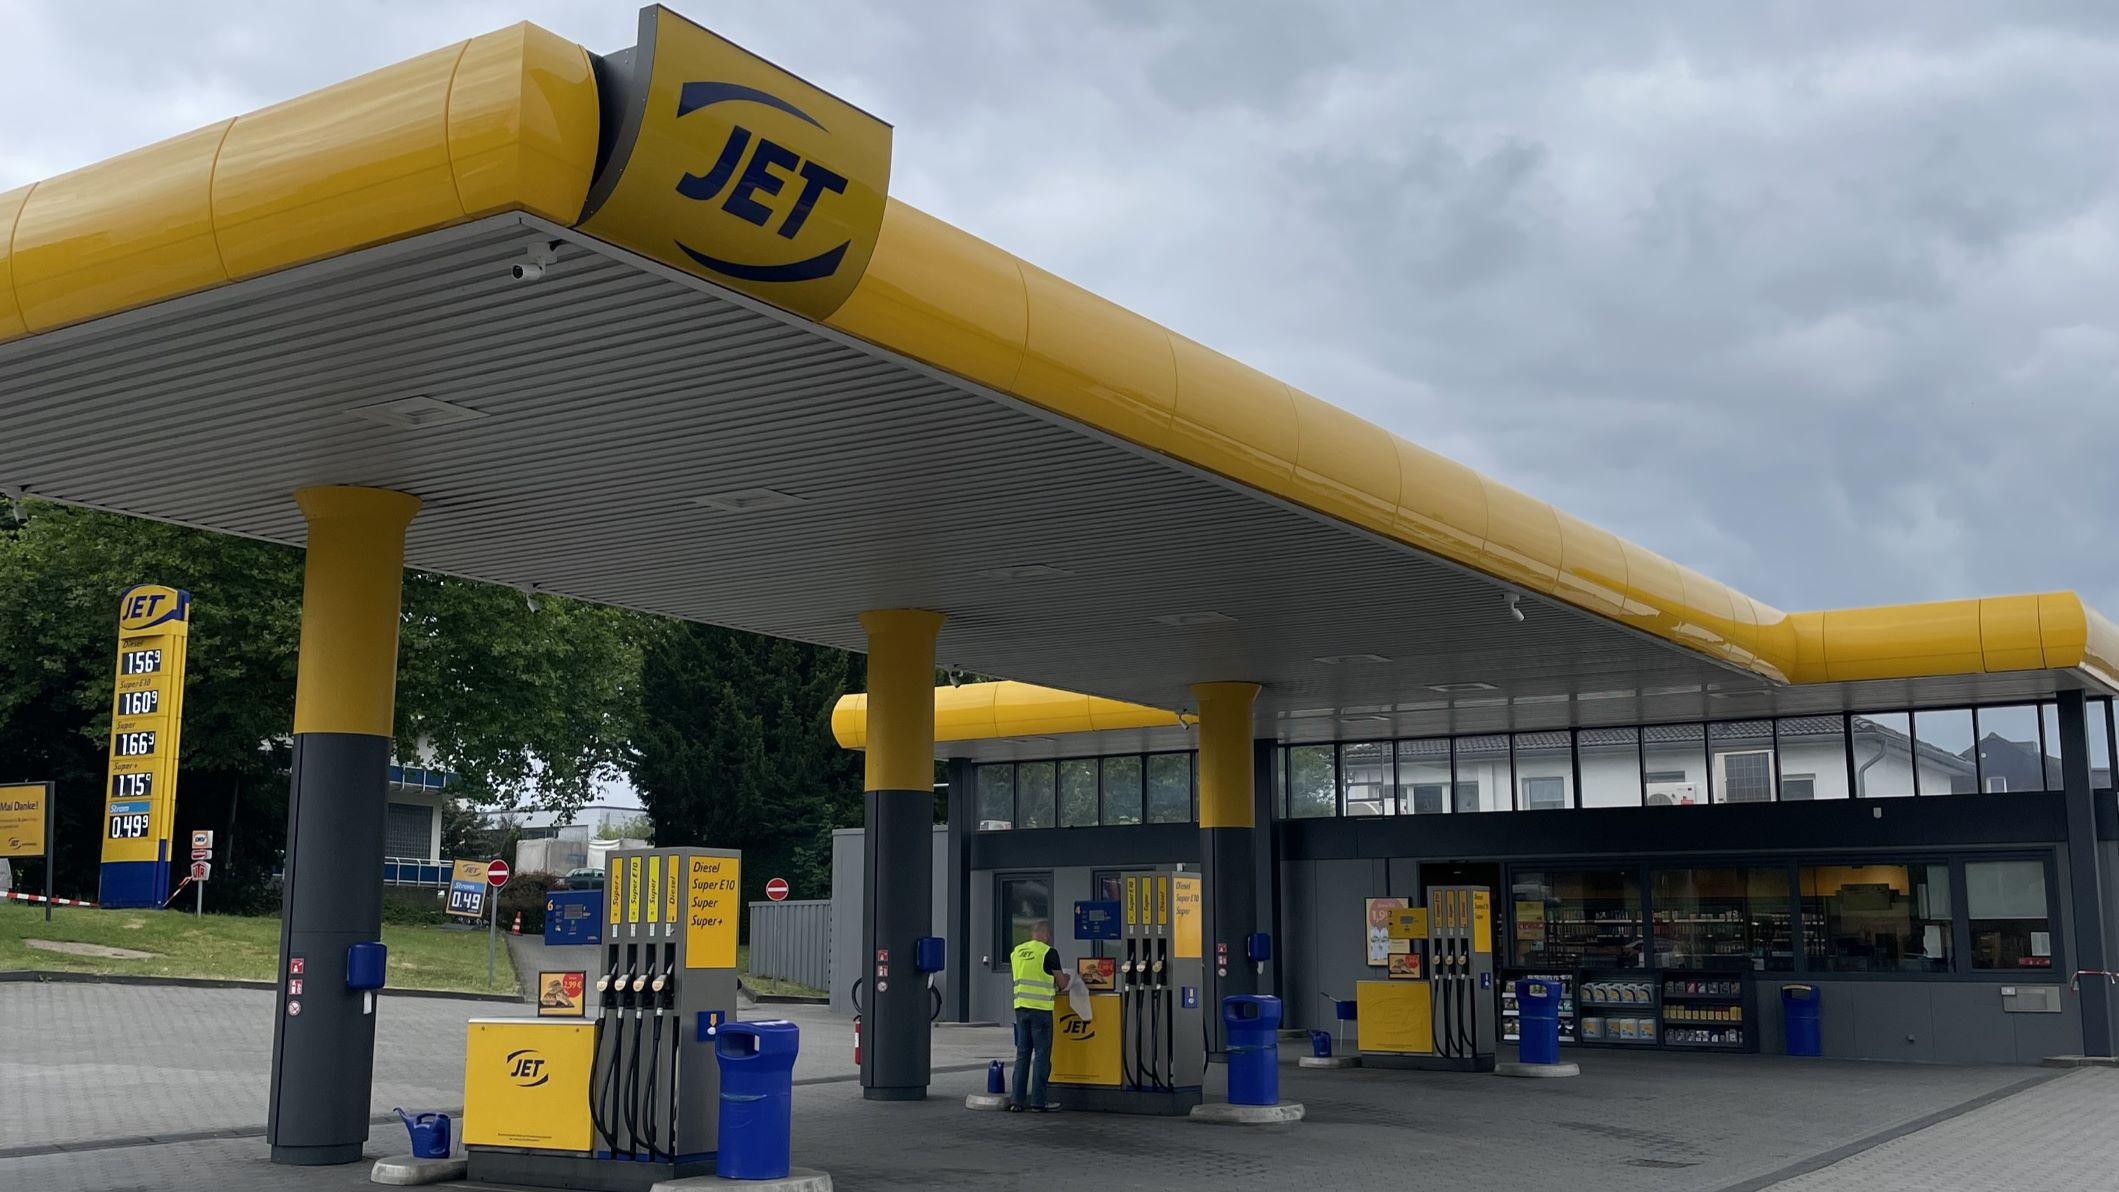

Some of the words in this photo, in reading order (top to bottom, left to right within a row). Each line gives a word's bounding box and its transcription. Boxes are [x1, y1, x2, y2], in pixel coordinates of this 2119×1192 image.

[675, 125, 849, 240] JET
[122, 595, 166, 620] JET
[122, 639, 143, 649] Diesel
[120, 680, 139, 690] Super
[116, 721, 136, 730] Super
[14, 801, 39, 811] Danke!
[110, 804, 129, 813] Strom
[693, 861, 720, 873] Diesel
[630, 879, 639, 906] Super
[649, 879, 658, 905] Super
[668, 876, 676, 905] Diesel
[692, 878, 718, 893] Super
[719, 879, 736, 891] E10
[451, 891, 481, 910] 0.49
[547, 899, 554, 911] 6
[692, 896, 718, 911] Super
[1019, 950, 1034, 958] JET
[1063, 1021, 1091, 1034] JET
[510, 1059, 545, 1077] JET
